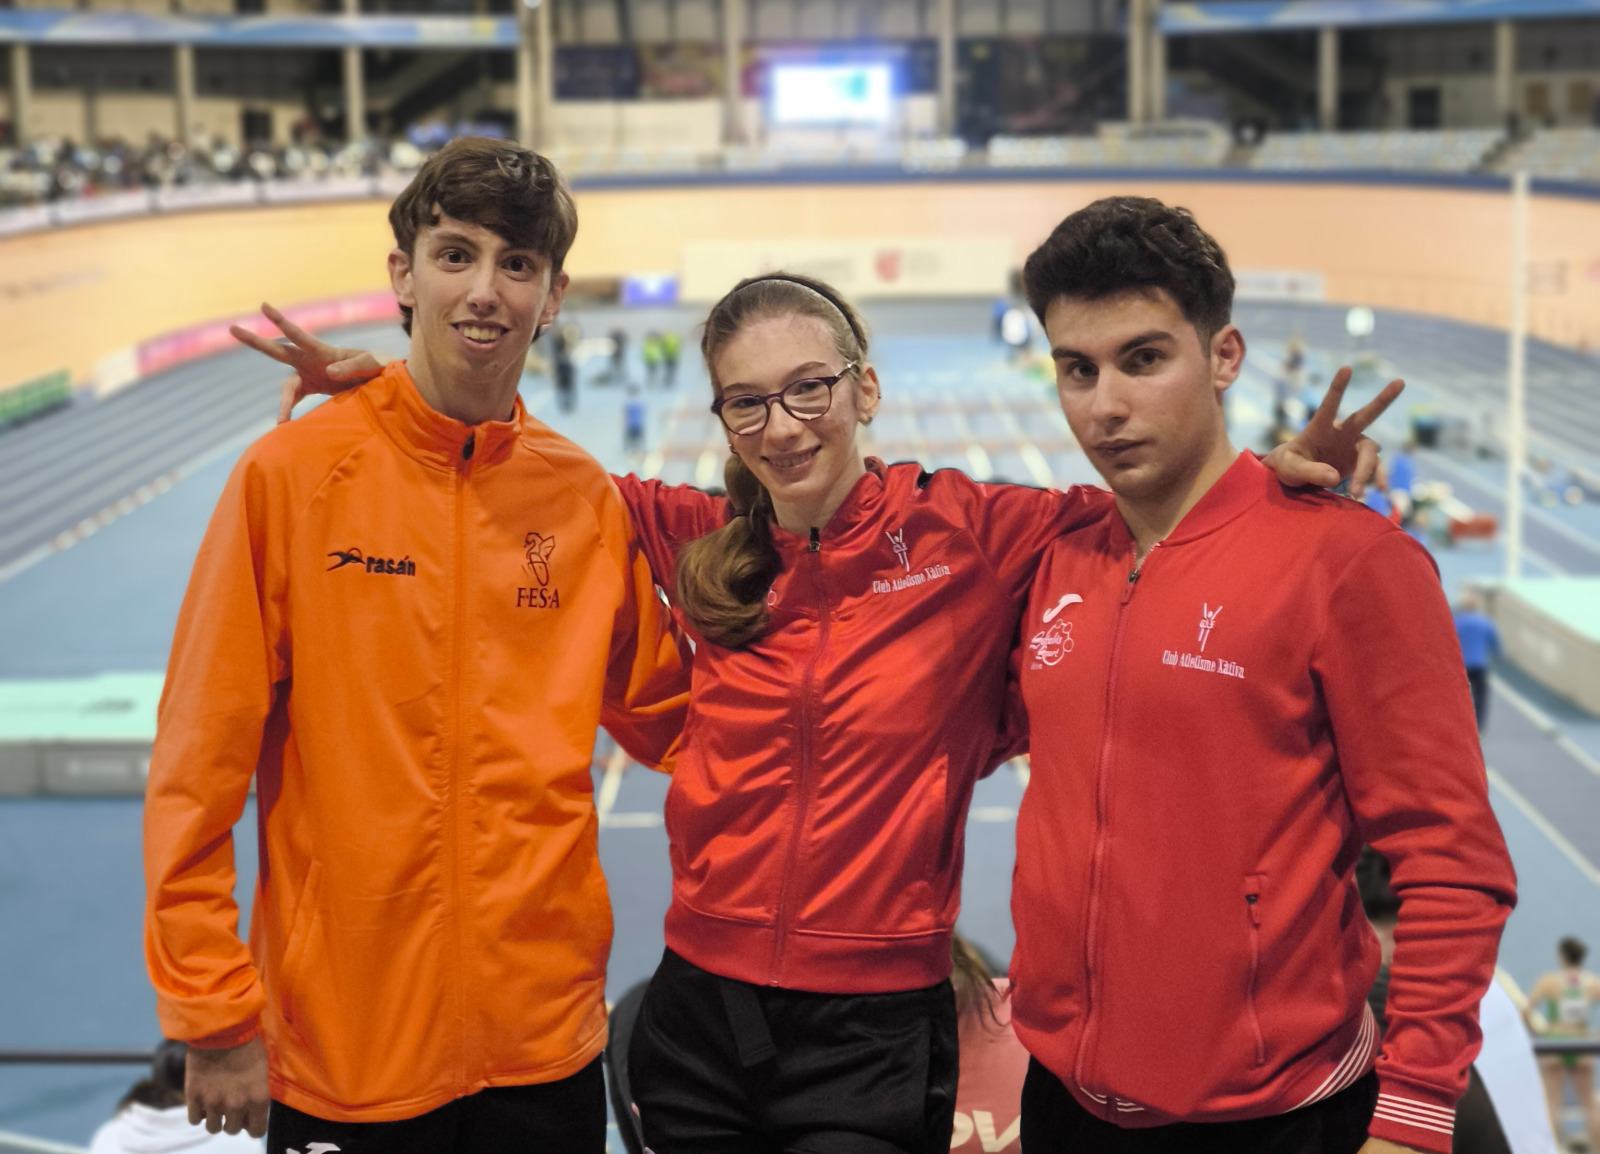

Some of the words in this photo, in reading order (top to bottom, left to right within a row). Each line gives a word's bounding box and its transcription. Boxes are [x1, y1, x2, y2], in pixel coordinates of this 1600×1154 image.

[365, 555, 416, 577] rasán
[872, 579, 891, 594] Club
[892, 573, 926, 592] Atletisme
[1162, 649, 1179, 666] Club
[1179, 652, 1217, 673] Atletisme
